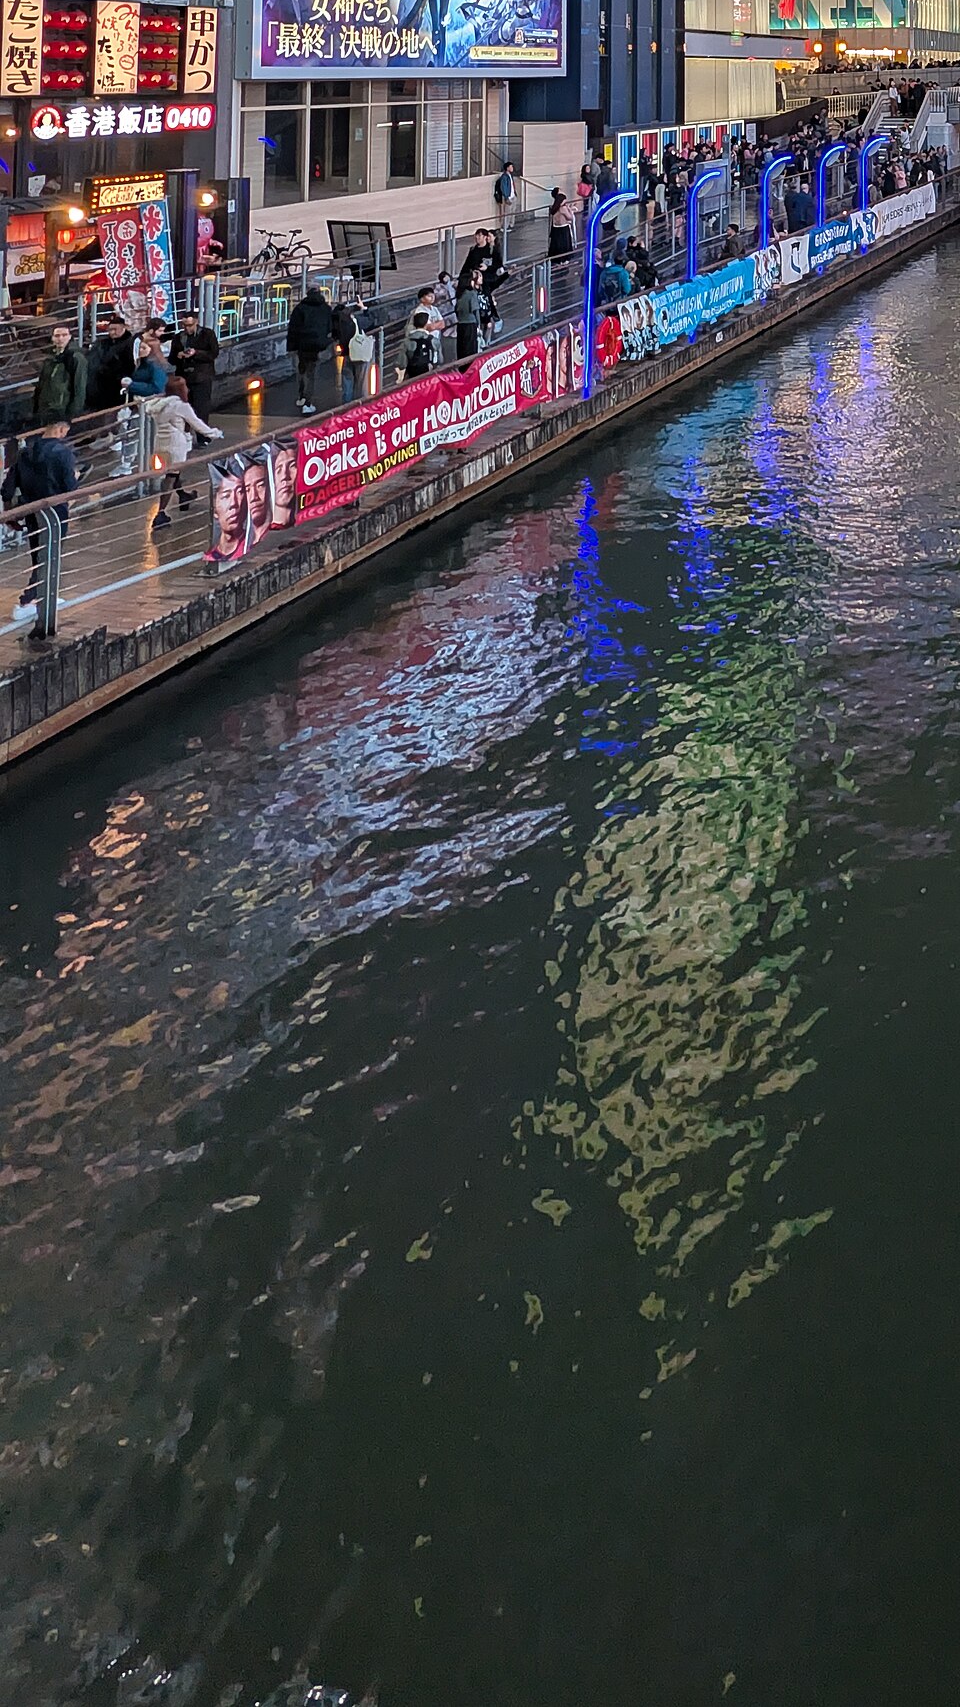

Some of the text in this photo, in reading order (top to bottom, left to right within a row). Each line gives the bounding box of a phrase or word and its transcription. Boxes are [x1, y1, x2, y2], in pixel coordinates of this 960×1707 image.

[188, 10, 215, 92] 串かつ
[266, 21, 438, 59] 「最終」決戦の地へ
[65, 105, 164, 138] 香港飯店
[166, 107, 211, 129] 0410
[486, 345, 522, 374] セレッソ大阪
[392, 418, 419, 445] our
[423, 371, 516, 432] HOMTOWN
[304, 426, 354, 456] Weome
[358, 420, 366, 436] to
[300, 470, 366, 509] [DAGER!]
[367, 463, 383, 481] NO
